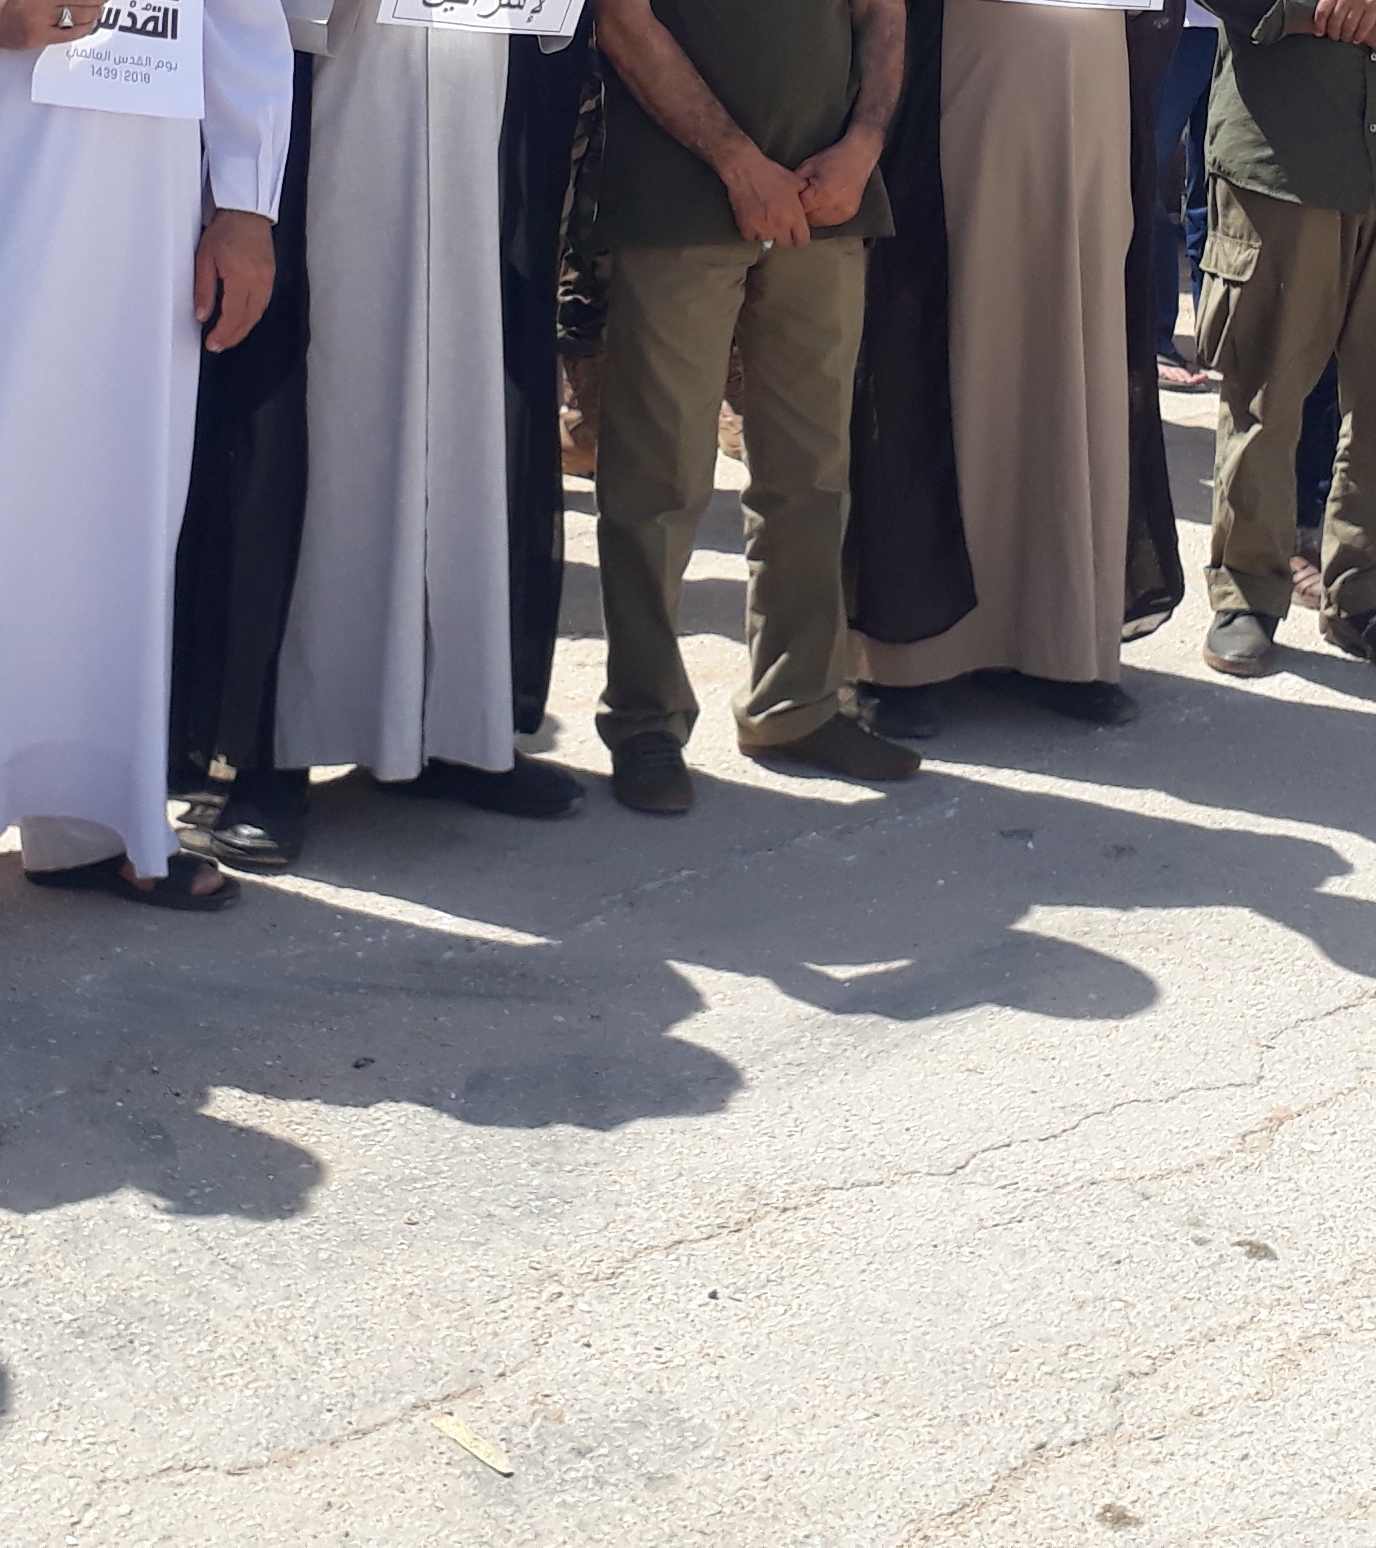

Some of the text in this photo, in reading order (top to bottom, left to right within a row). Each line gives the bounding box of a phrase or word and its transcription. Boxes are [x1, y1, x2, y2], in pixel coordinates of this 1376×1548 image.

[65, 45, 178, 72] يوم القدس العالمي
[90, 64, 118, 80] 1439
